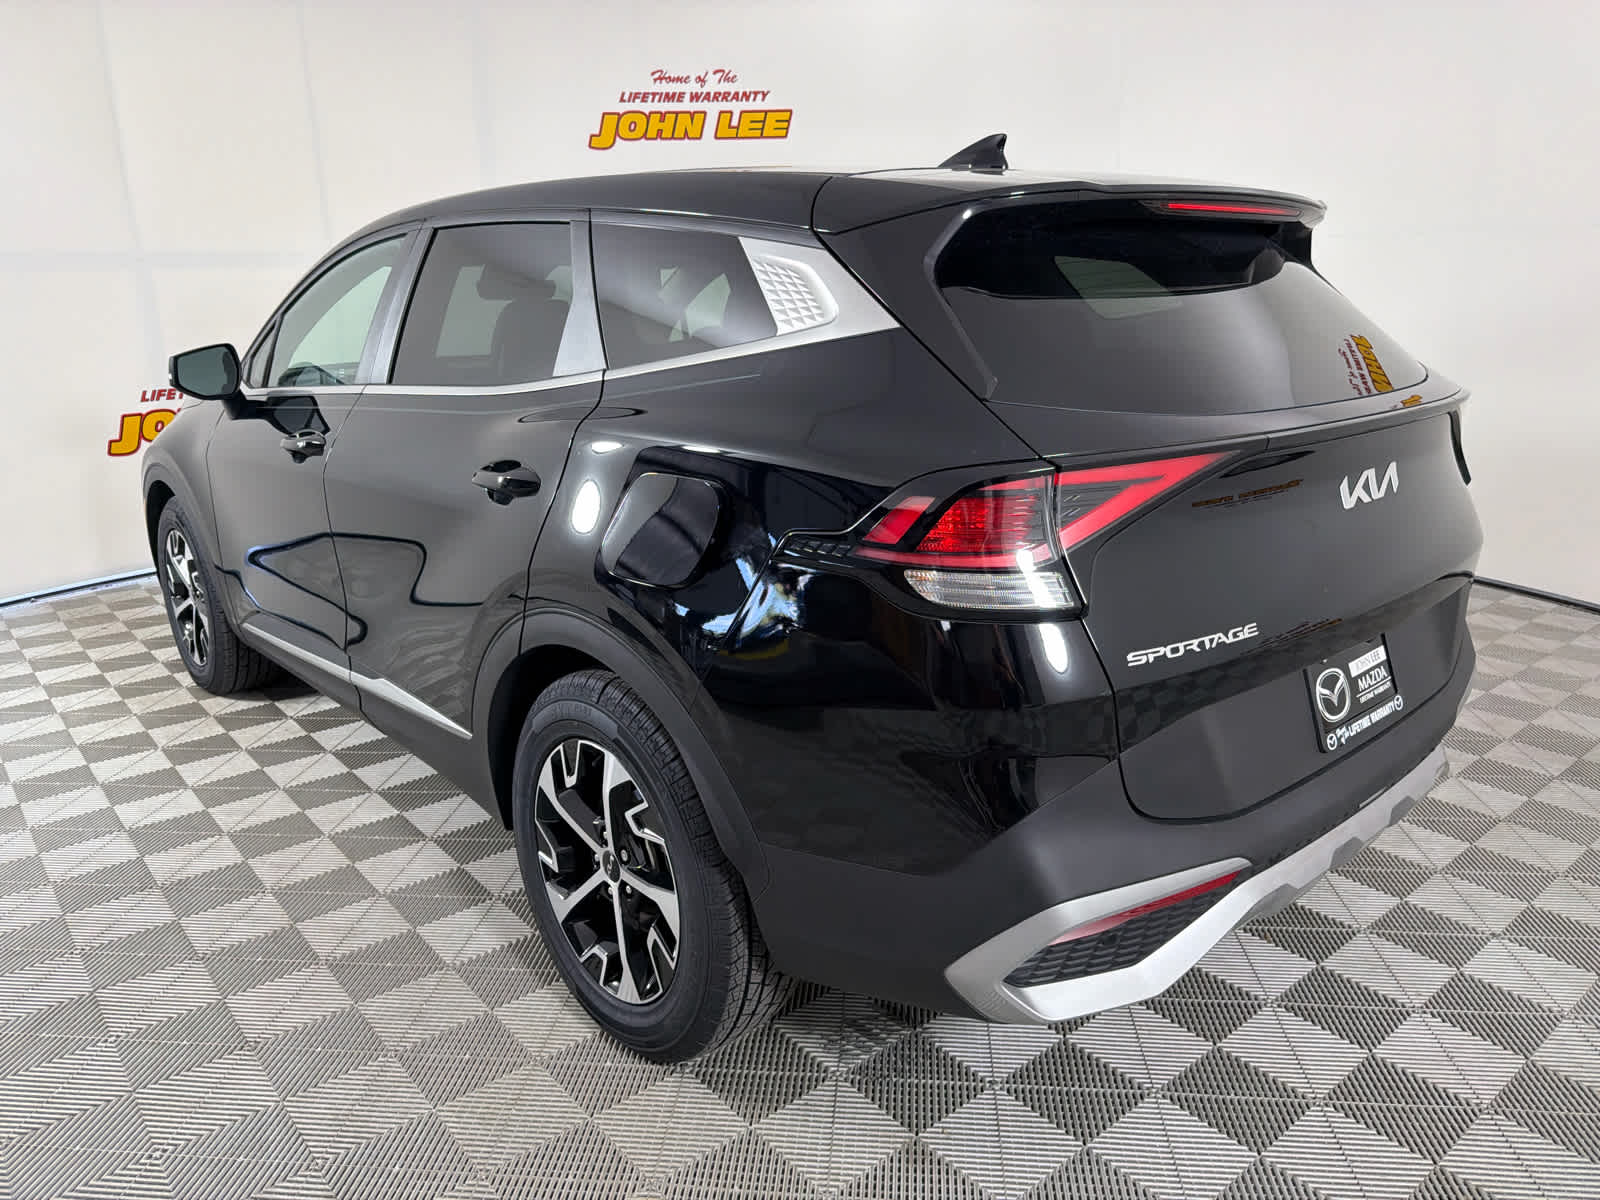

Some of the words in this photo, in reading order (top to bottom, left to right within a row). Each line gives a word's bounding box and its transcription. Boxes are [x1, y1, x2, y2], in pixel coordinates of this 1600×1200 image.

[650, 69, 690, 84] Home
[693, 73, 709, 88] of
[712, 69, 738, 84] The
[619, 91, 685, 104] LIFETIME
[689, 90, 771, 104] WARRANTY
[588, 109, 707, 150] JOHN
[714, 108, 793, 140] LEE
[140, 388, 184, 402] LIFE
[107, 408, 180, 456] JO
[1339, 461, 1400, 510] KIA
[1126, 622, 1260, 667] SPORTAGE
[1358, 665, 1388, 692] MAZDA
[1348, 715, 1372, 737] LIFETIME
